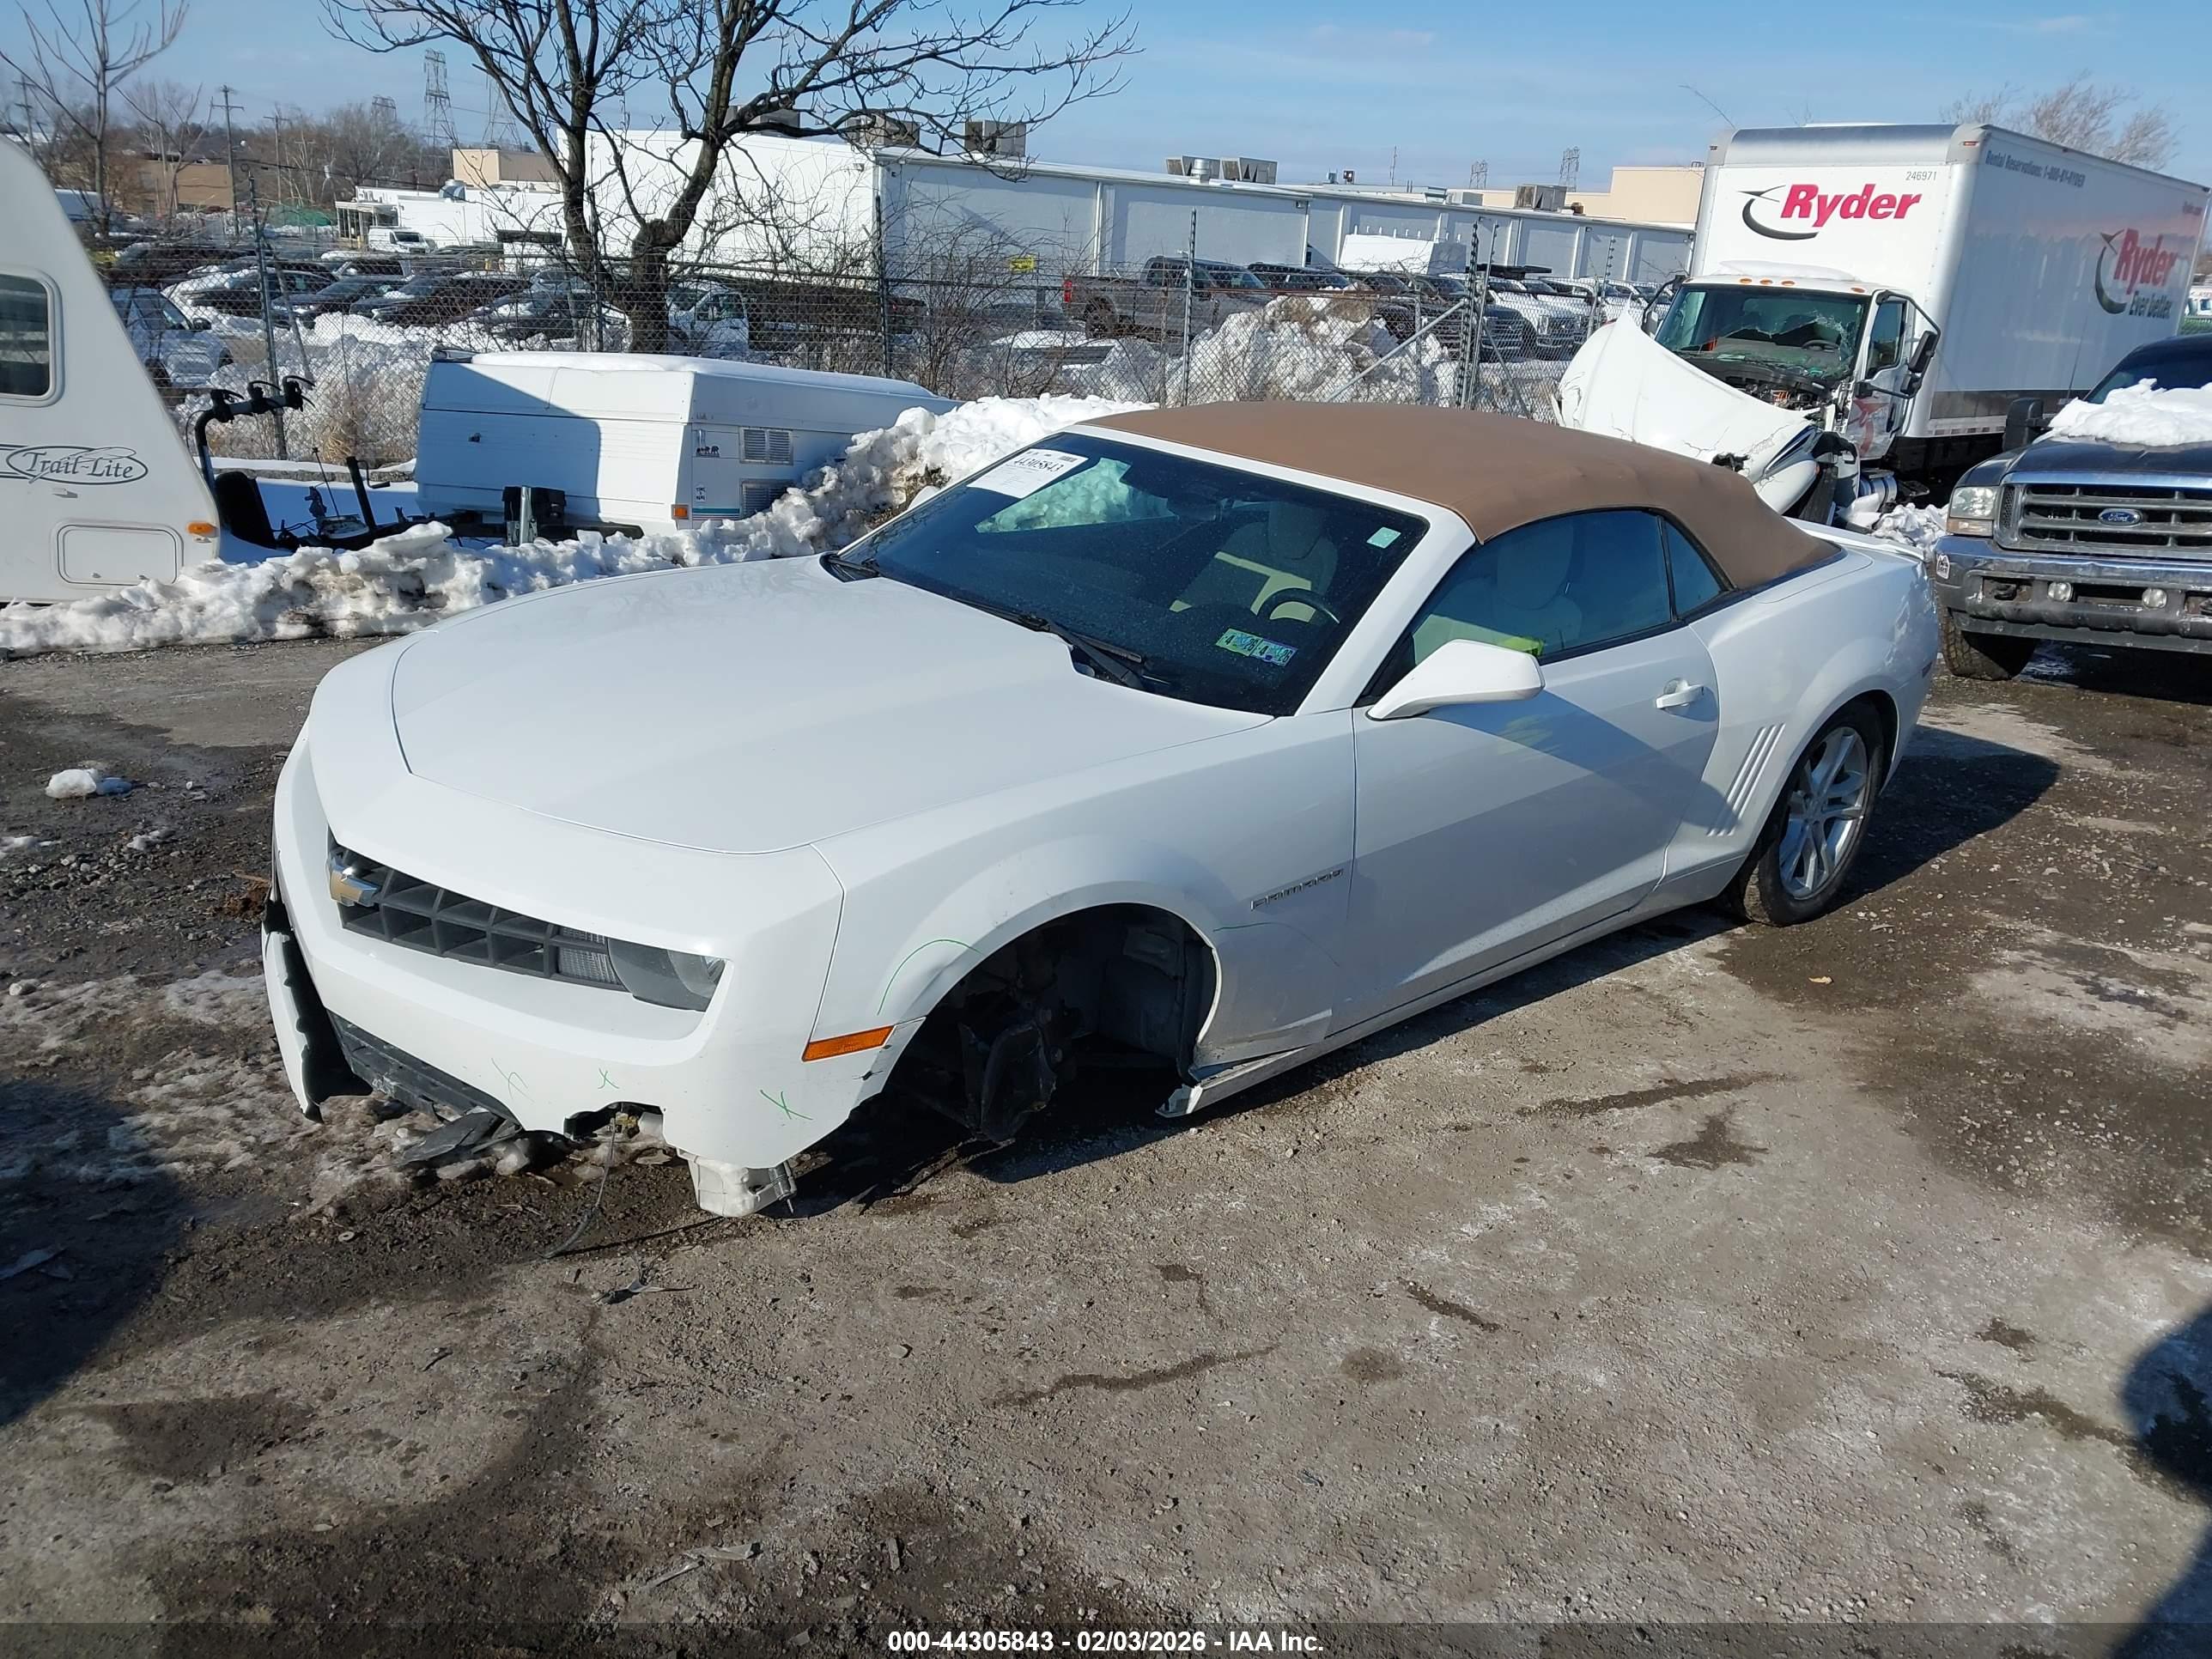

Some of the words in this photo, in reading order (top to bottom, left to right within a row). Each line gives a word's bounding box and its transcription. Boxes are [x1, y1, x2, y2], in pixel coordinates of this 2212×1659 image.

[1905, 171, 1937, 181] 246971
[1780, 183, 1923, 228] Ryder
[2113, 228, 2179, 295] Ryder
[2129, 290, 2149, 317] Ever
[2107, 512, 2130, 522] Ford
